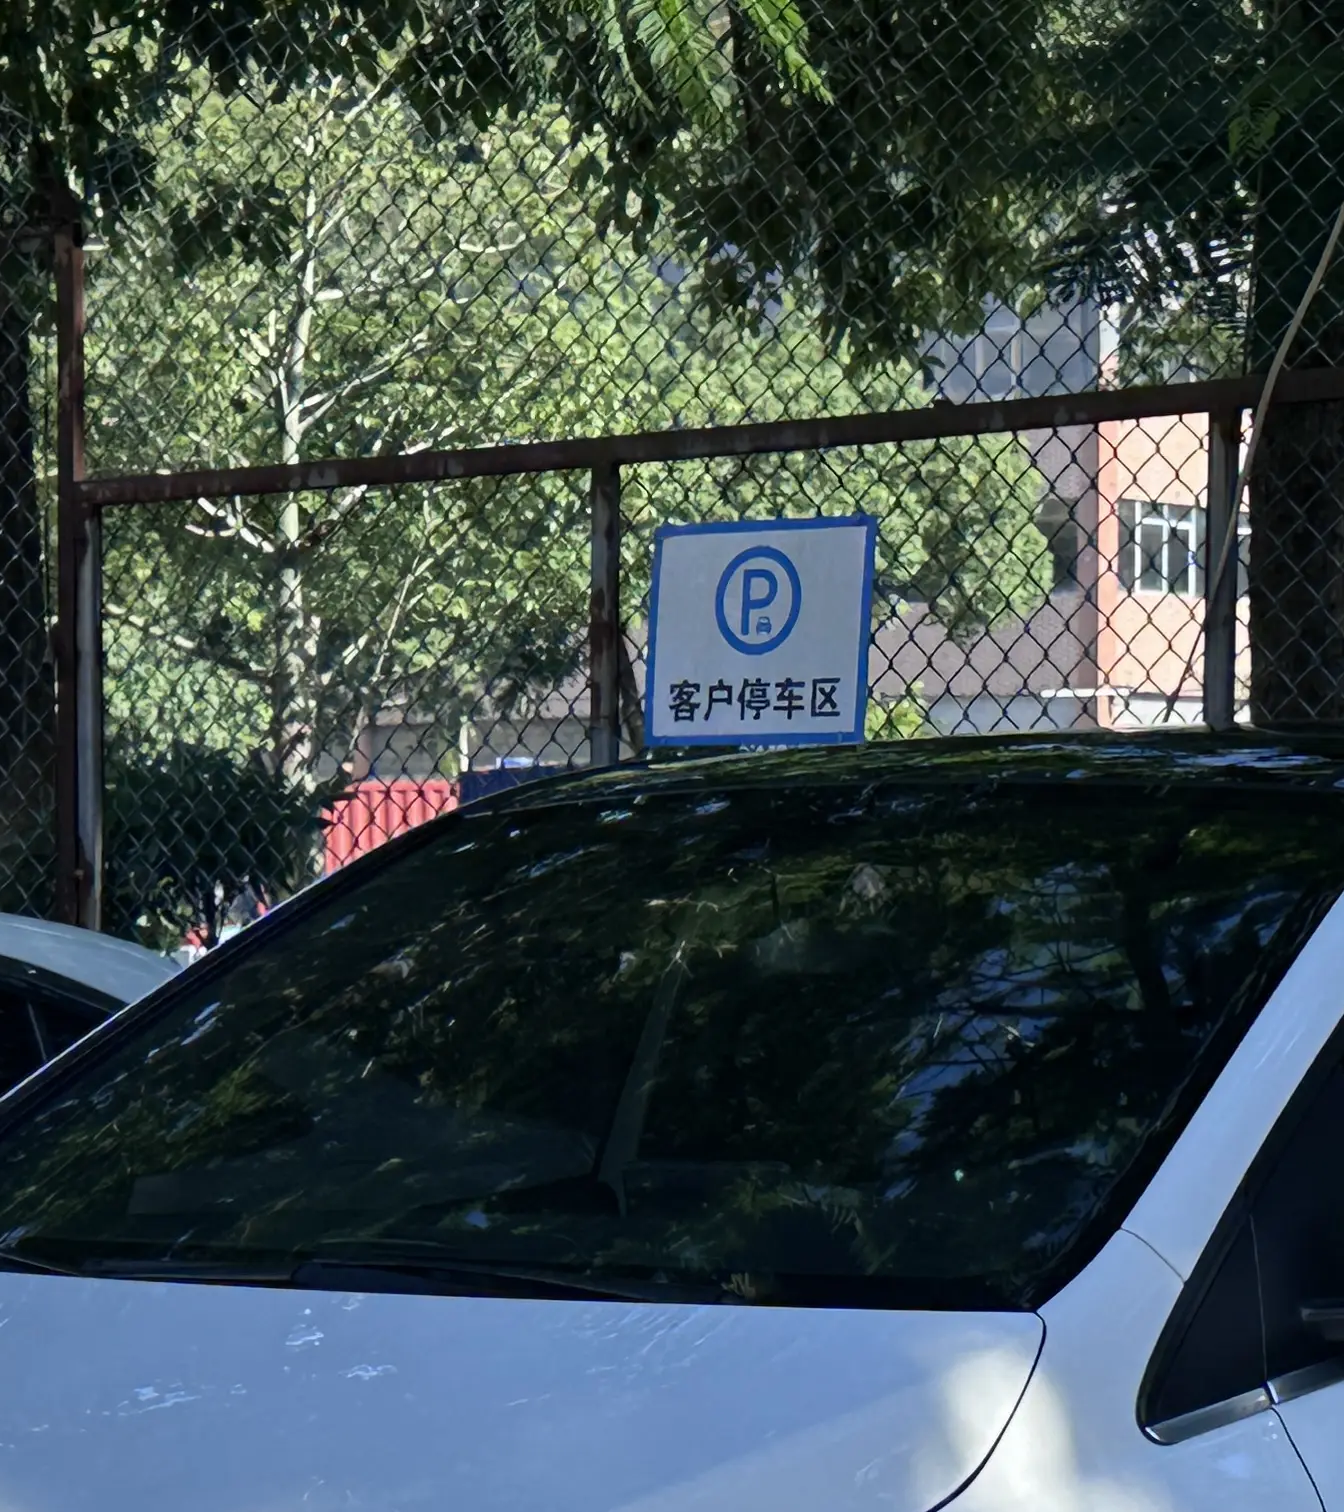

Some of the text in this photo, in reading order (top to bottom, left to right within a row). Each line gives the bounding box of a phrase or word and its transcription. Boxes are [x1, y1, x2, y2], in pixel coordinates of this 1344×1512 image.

[669, 678, 841, 722] 客户停车区
